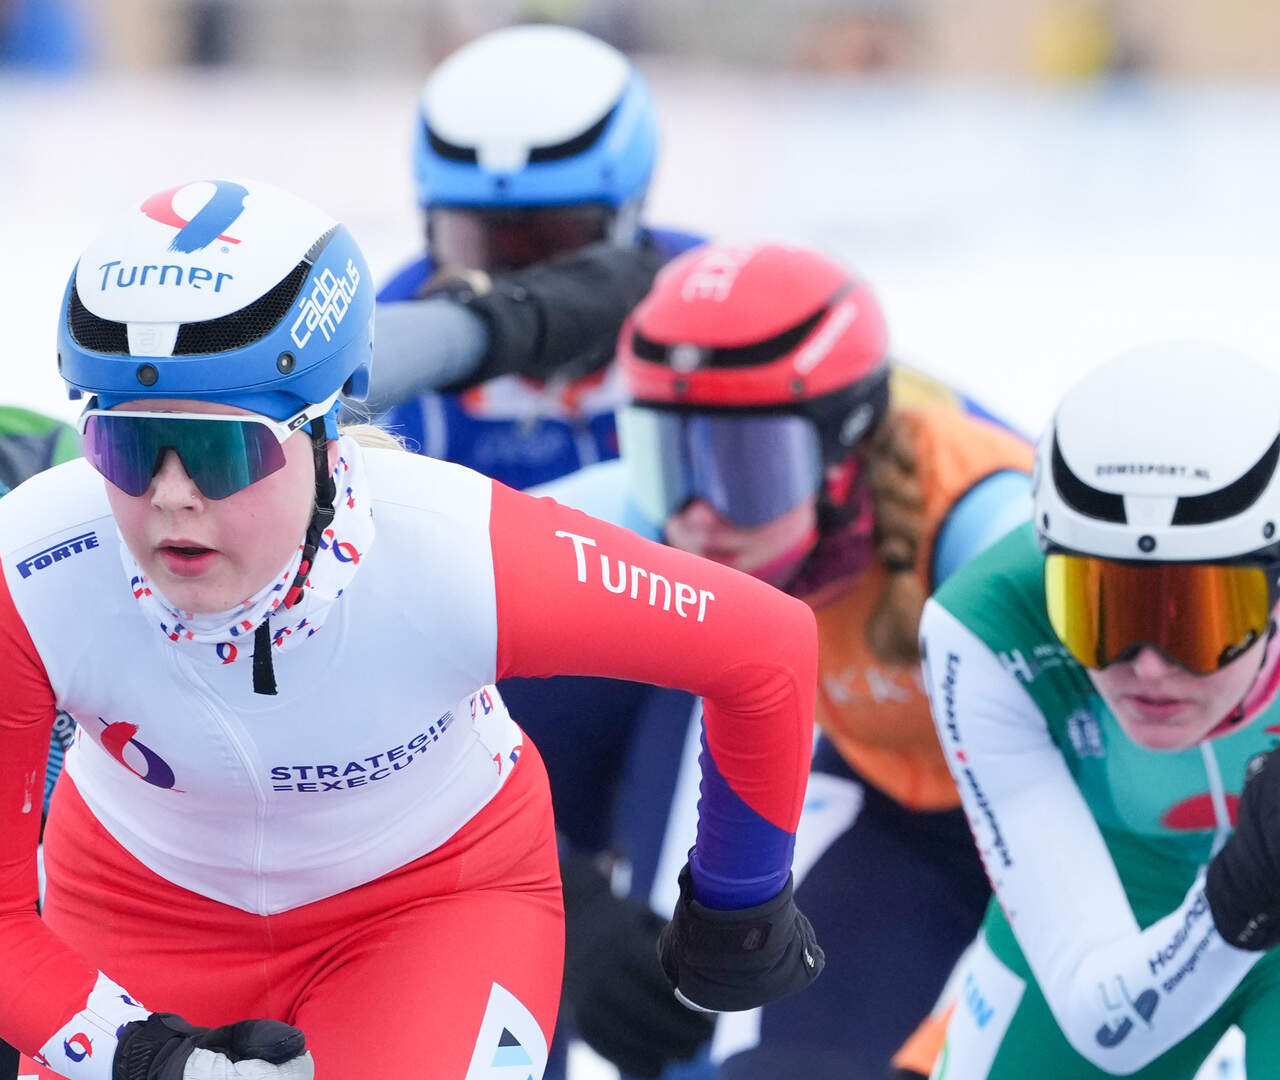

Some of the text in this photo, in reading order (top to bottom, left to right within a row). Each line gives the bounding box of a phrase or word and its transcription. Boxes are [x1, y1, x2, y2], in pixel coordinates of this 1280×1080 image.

[99, 260, 234, 293] Turner
[16, 531, 99, 579] FORTE
[555, 530, 716, 622] Turner
[271, 710, 454, 781] STRATEGIE
